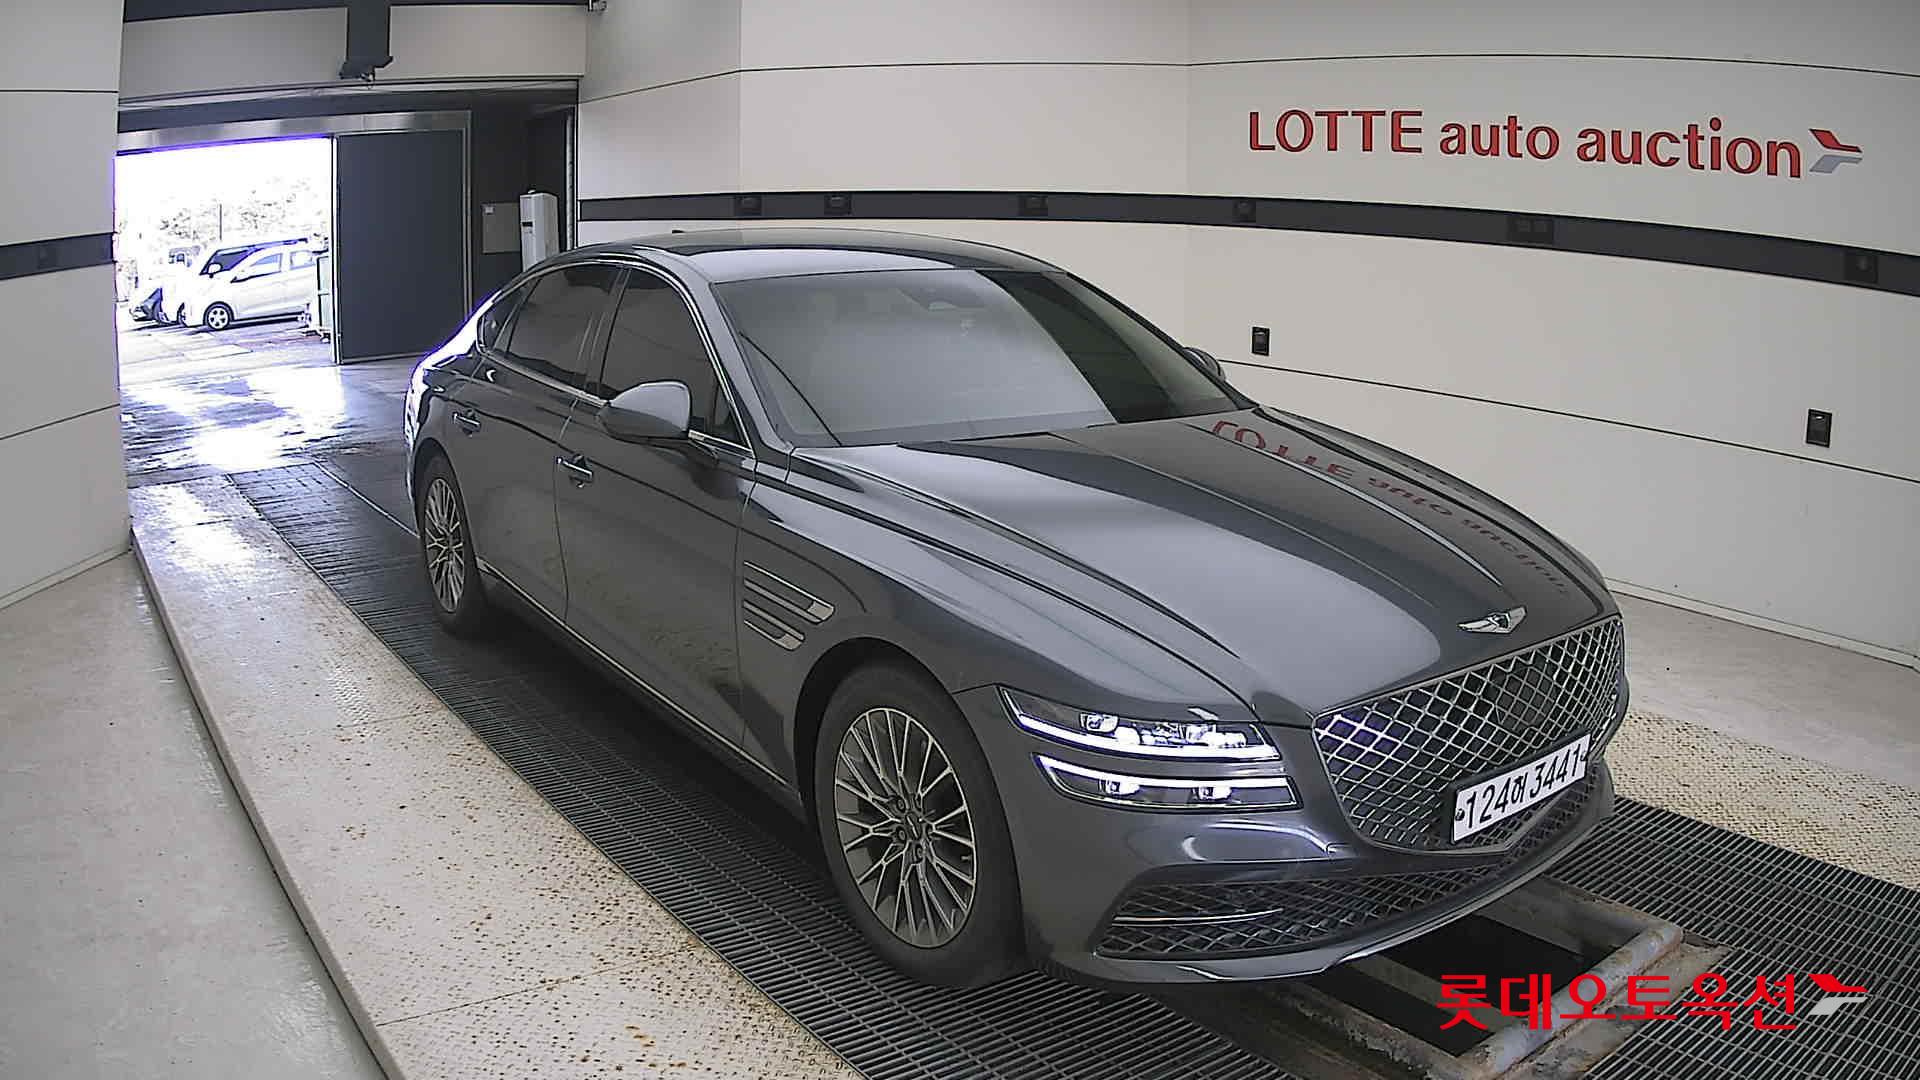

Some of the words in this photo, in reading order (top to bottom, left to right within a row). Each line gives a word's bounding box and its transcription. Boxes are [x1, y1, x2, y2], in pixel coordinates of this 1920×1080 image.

[1249, 110, 1424, 154] LOTTE
[1439, 115, 1560, 160] auto
[1576, 117, 1802, 178] auction
[1530, 743, 1581, 798] 3441
